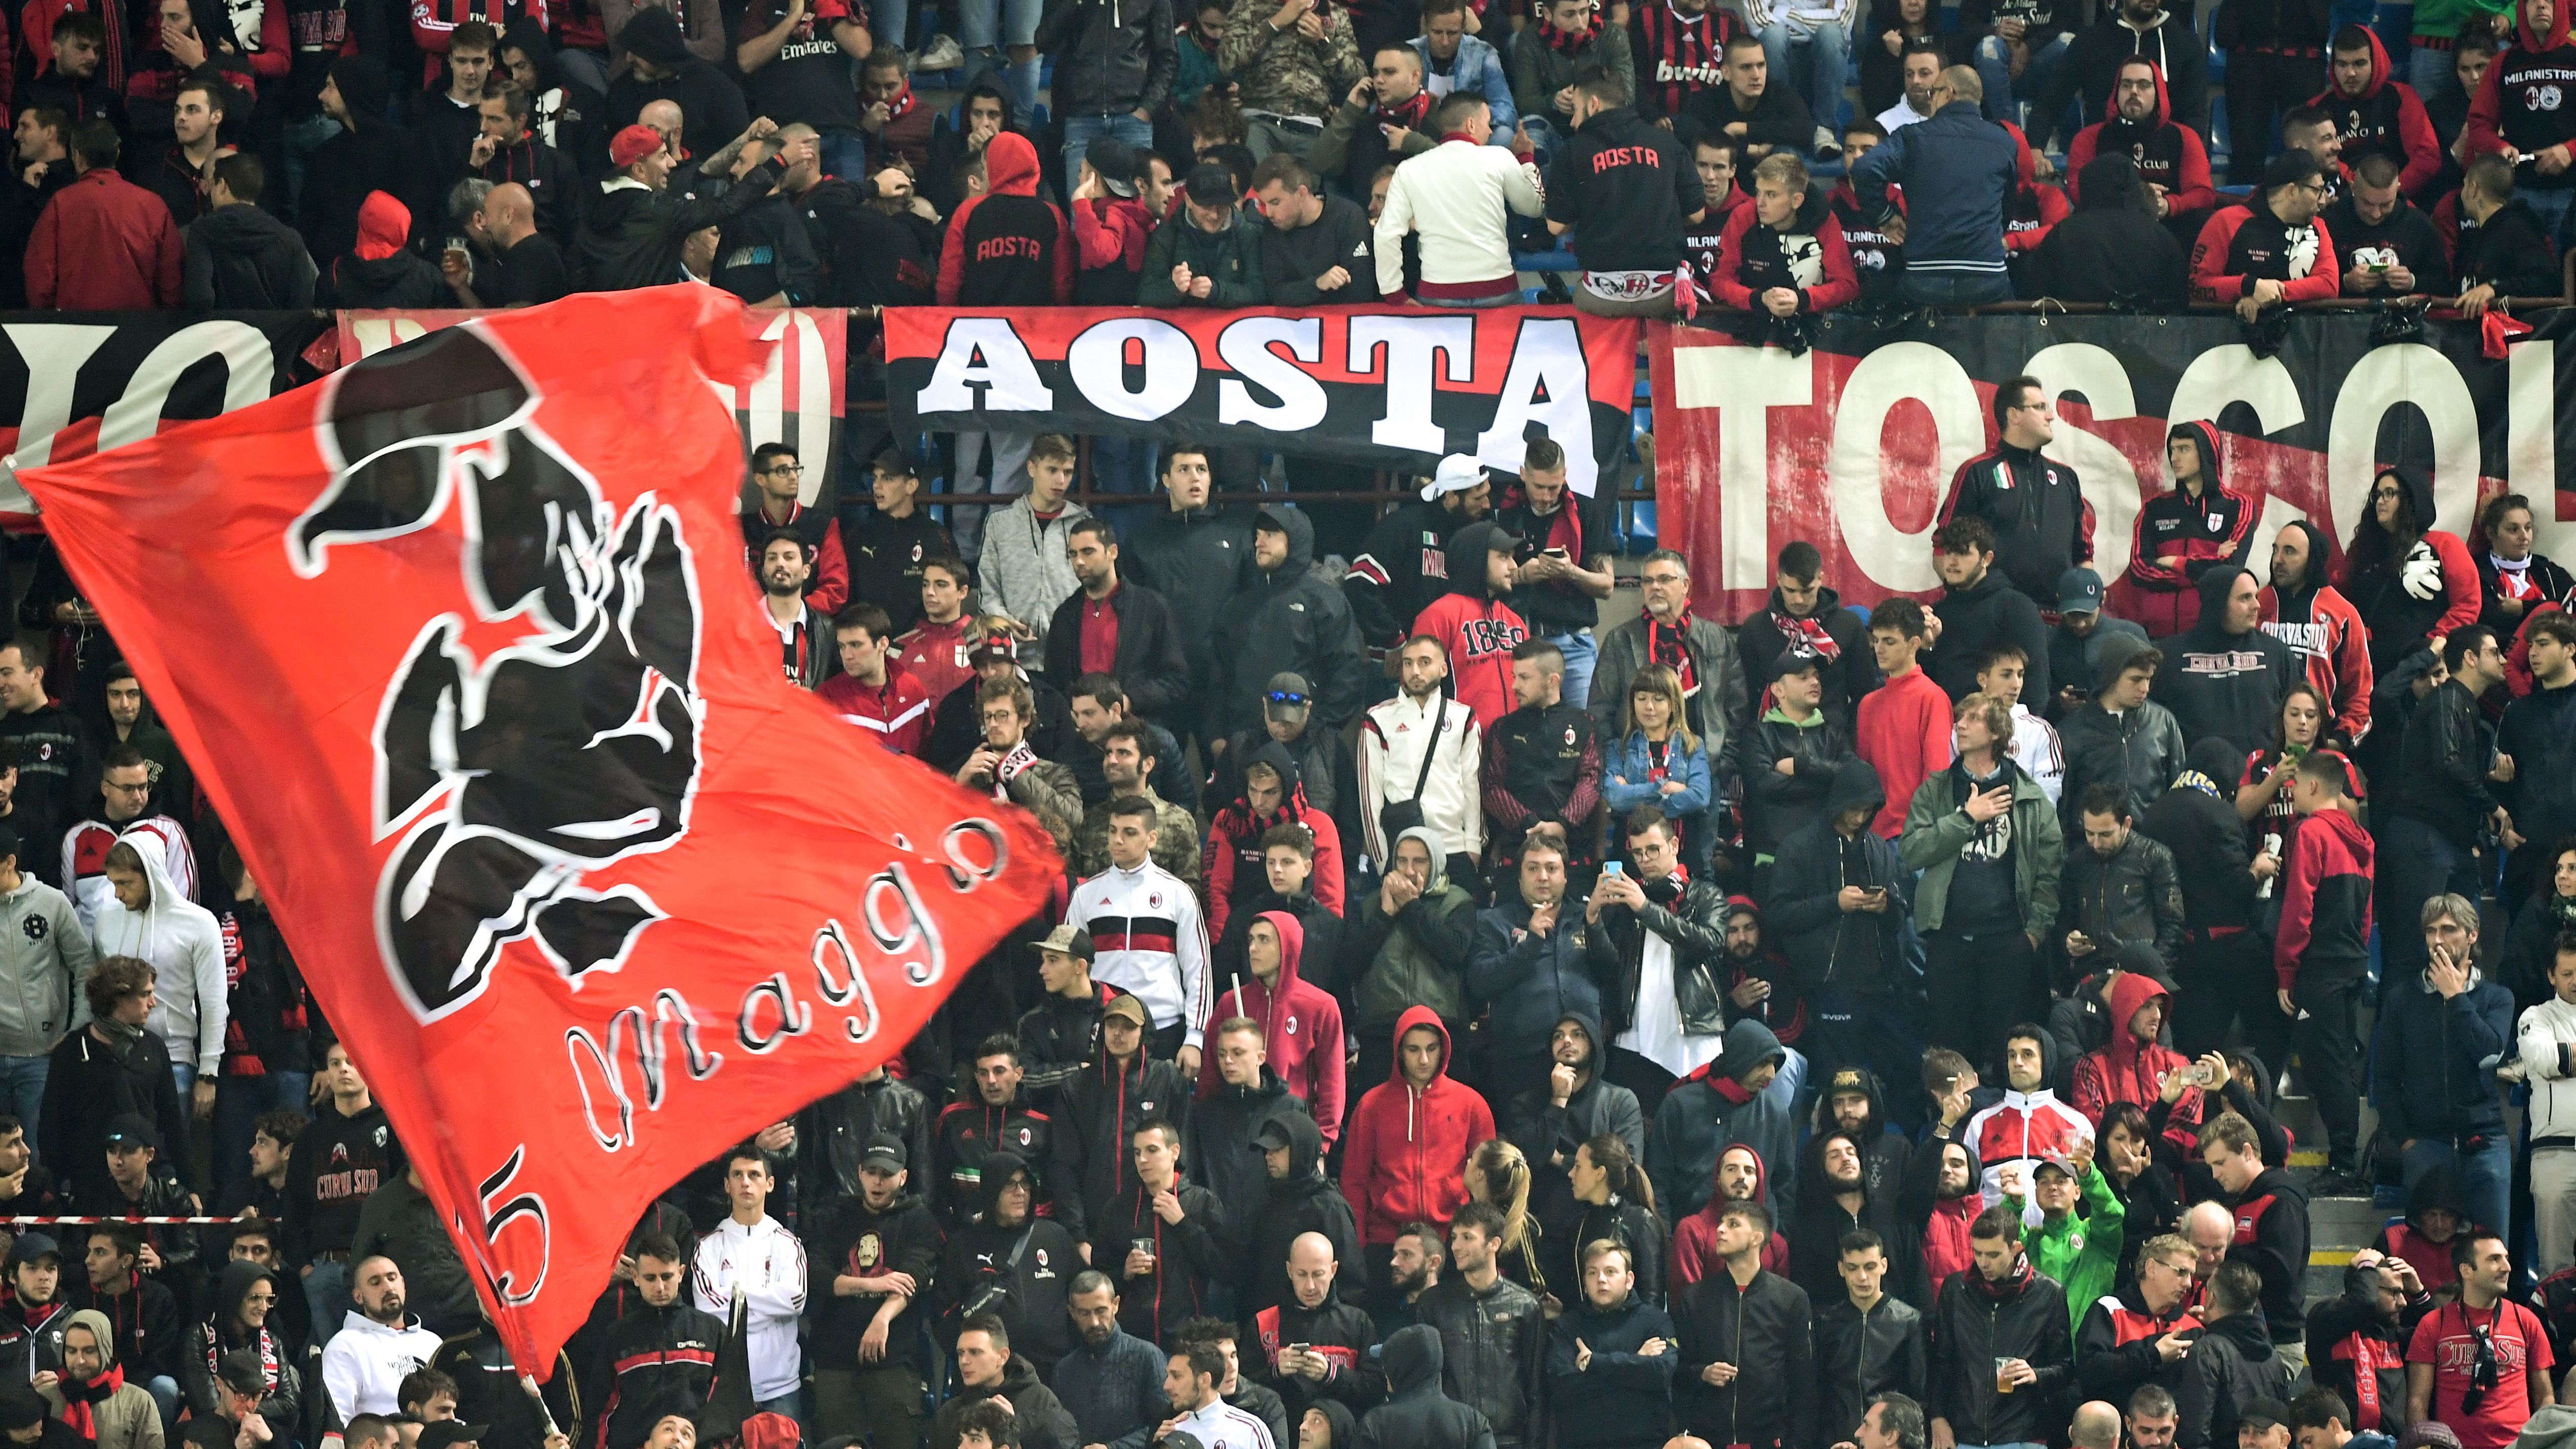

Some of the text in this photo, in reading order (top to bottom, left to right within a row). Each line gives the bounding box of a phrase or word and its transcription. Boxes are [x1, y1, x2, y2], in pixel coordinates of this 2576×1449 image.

[782, 40, 837, 61] Emirates
[1656, 59, 1724, 85] bwin
[2504, 68, 2576, 86] MILANISTRA
[1592, 145, 1659, 175] AOSTA
[2144, 160, 2169, 170] CLUB
[977, 237, 1042, 264] AOSTA
[917, 314, 1599, 499] AOSTA
[1462, 618, 1525, 657] 1899
[2191, 655, 2257, 669] CURVA SUD
[317, 1168, 378, 1200] CURVA SUD
[477, 1143, 550, 1308] 5
[677, 1340, 698, 1349] OPEL
[2437, 1341, 2479, 1366] CURV
